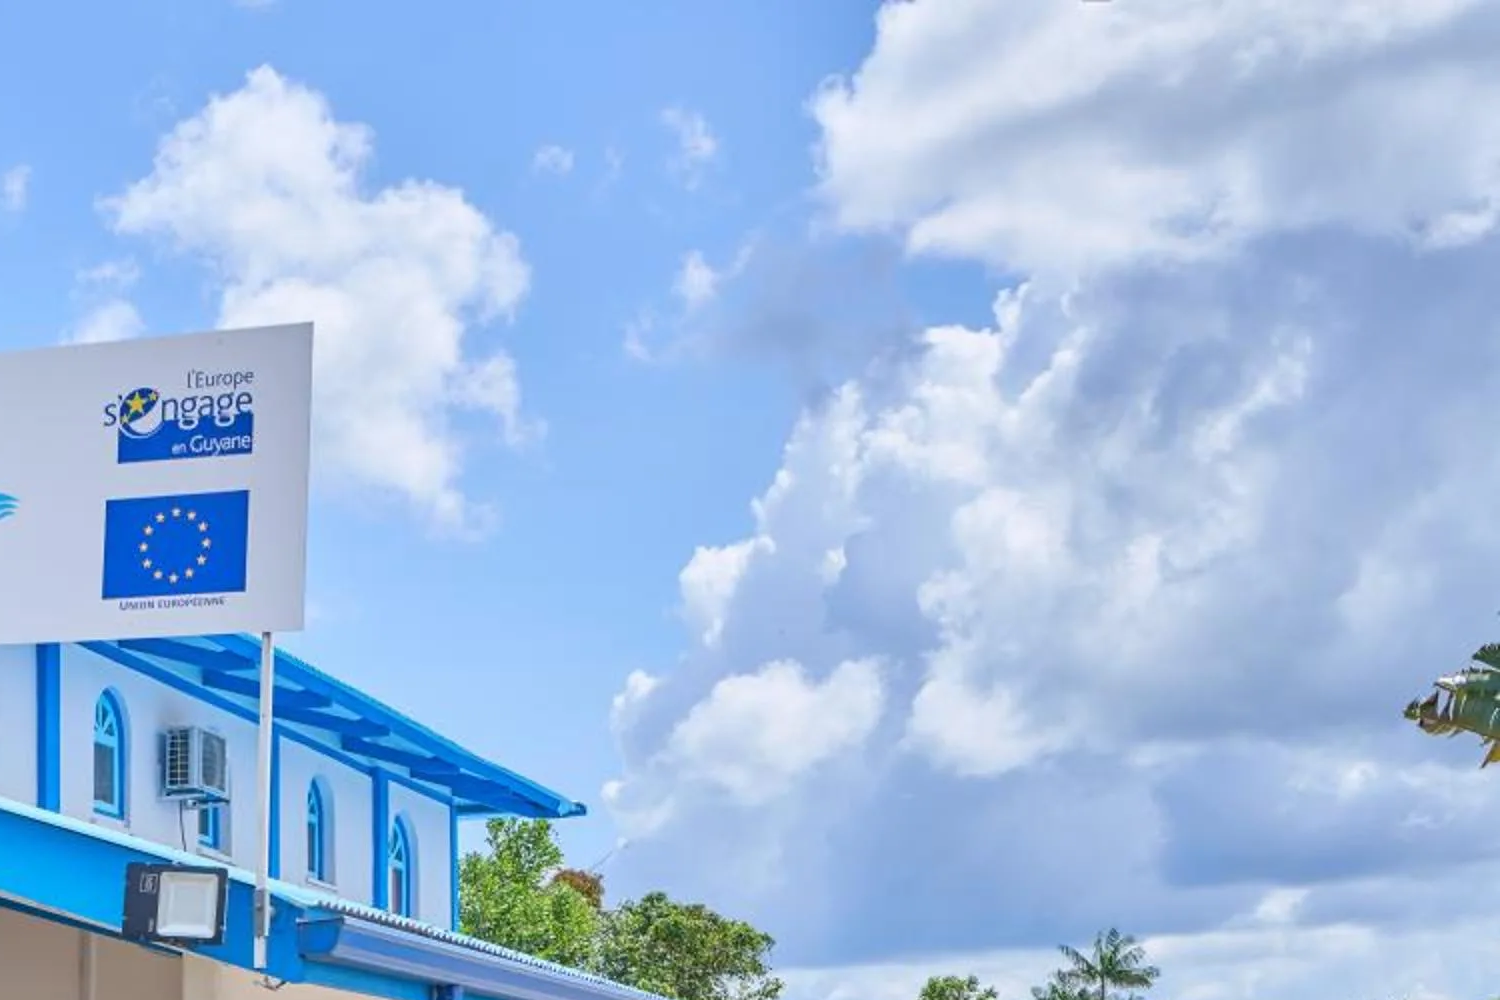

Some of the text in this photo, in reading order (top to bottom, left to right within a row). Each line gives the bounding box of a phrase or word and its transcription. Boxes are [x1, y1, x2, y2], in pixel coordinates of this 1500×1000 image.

[187, 370, 254, 389] l'Europe
[171, 435, 251, 456] en Guyane
[119, 600, 155, 611] UNION
